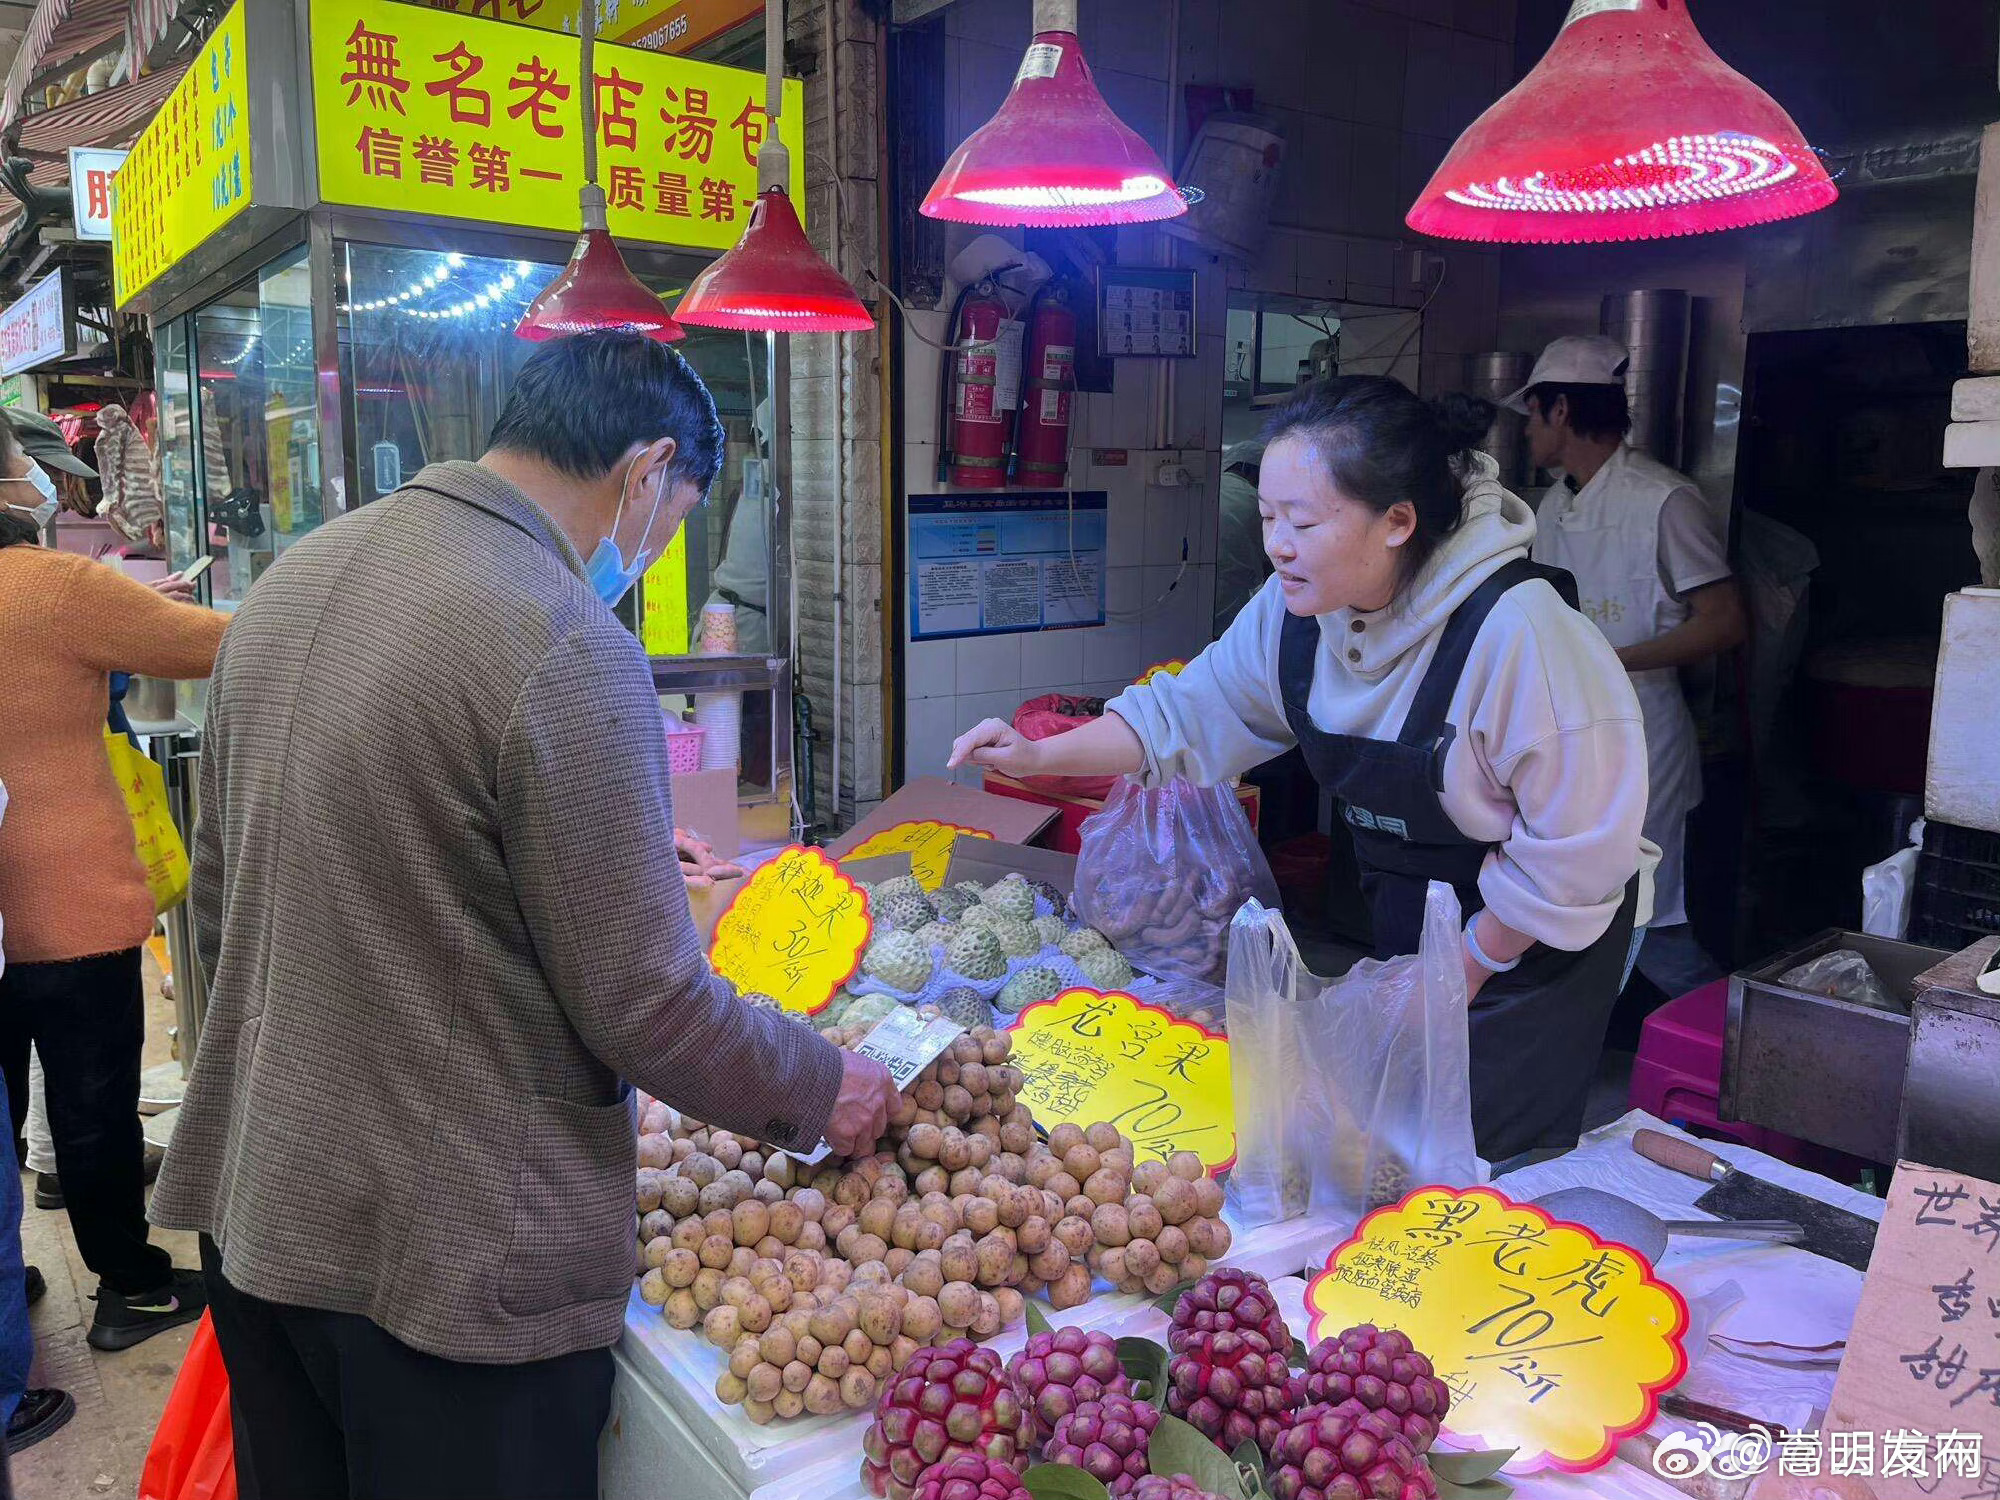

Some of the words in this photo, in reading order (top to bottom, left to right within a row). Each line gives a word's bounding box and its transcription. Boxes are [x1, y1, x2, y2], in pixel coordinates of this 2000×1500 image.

[340, 18, 776, 168] 無名老店湯包
[355, 125, 563, 193] 信誉第一
[773, 852, 854, 941] 释迦果
[1044, 1001, 1211, 1085] 龙宫果
[1404, 1198, 1627, 1318] 黑老虎
